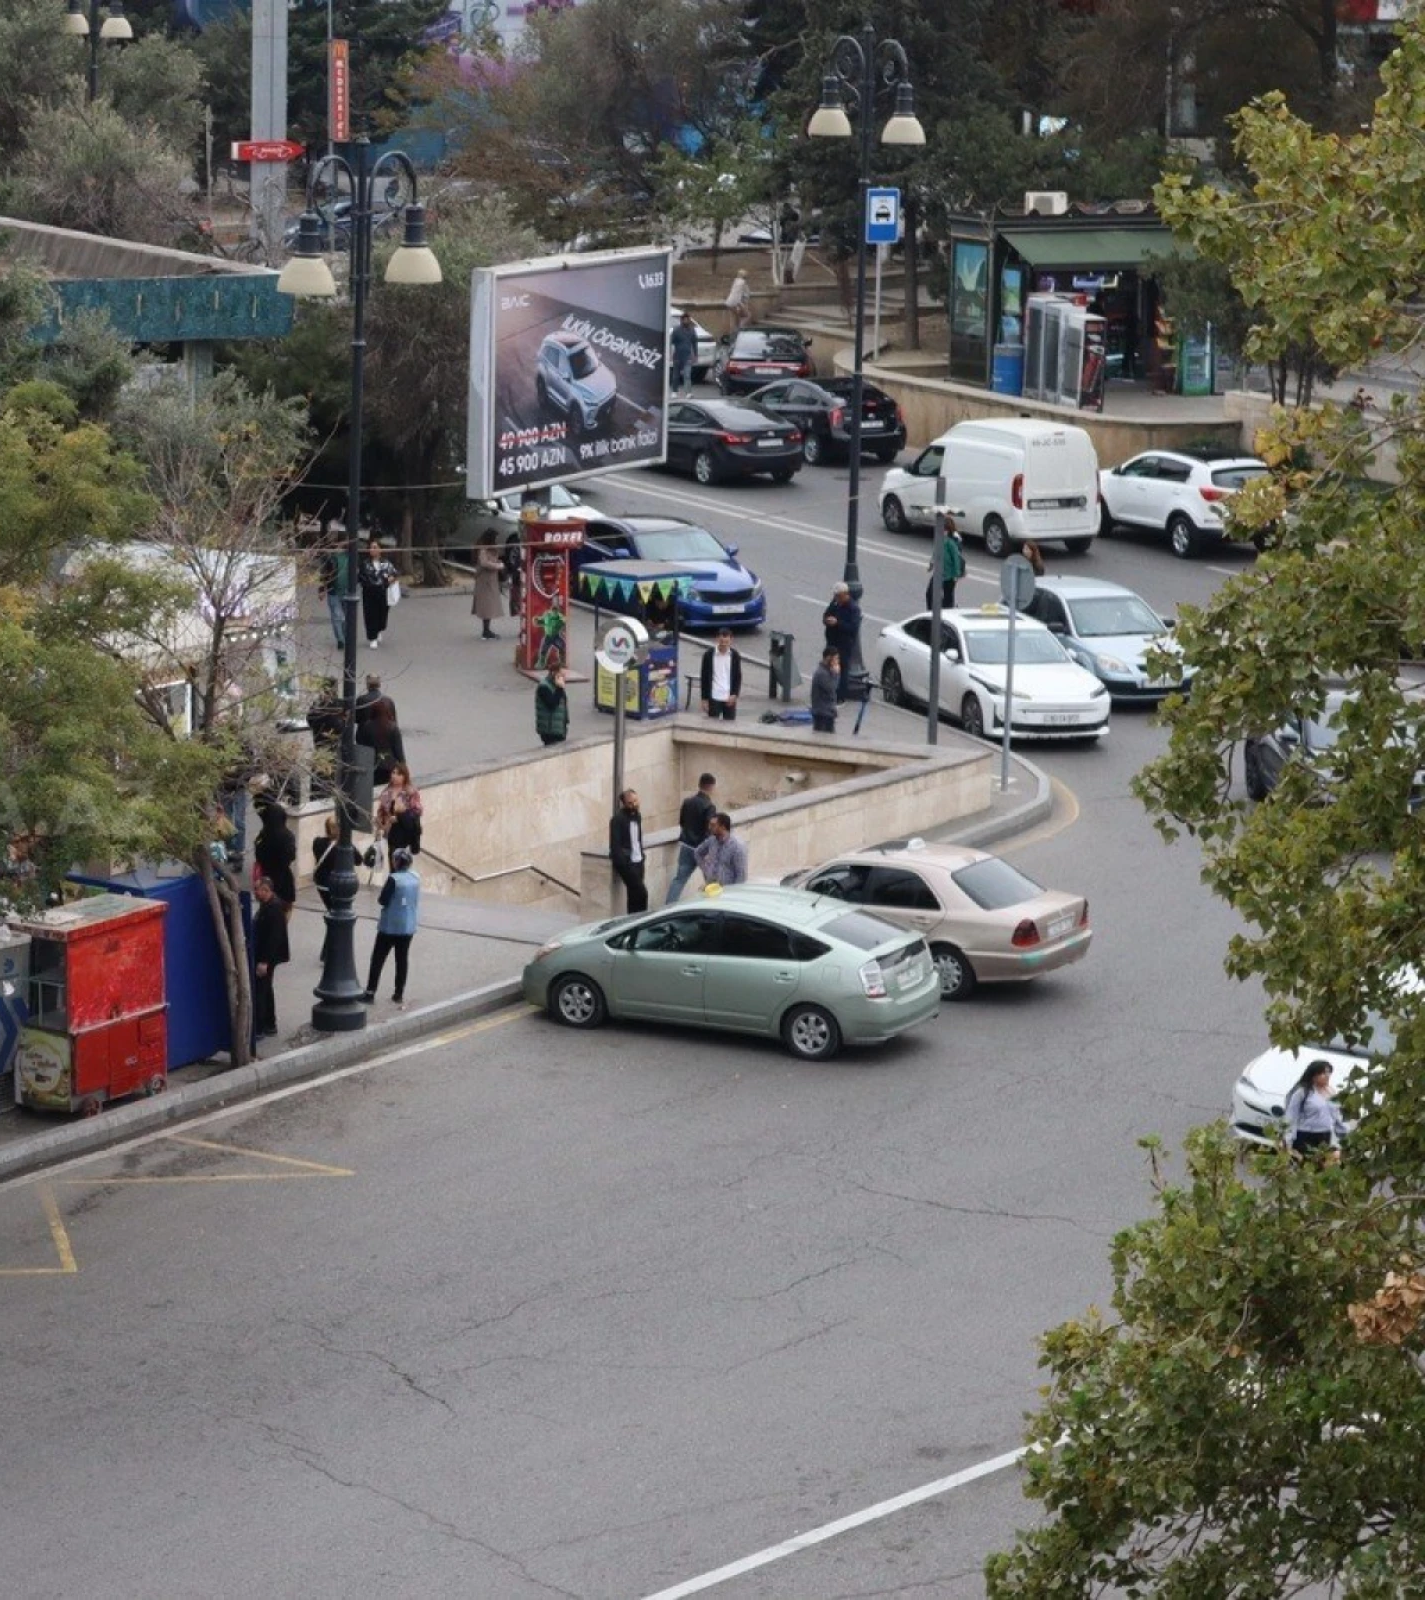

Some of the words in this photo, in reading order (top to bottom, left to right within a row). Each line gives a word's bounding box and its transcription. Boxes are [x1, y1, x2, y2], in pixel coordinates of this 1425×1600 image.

[610, 434, 636, 453] bank
[499, 456, 515, 476] 45
[516, 452, 539, 473] 900
[541, 446, 567, 468] AZN
